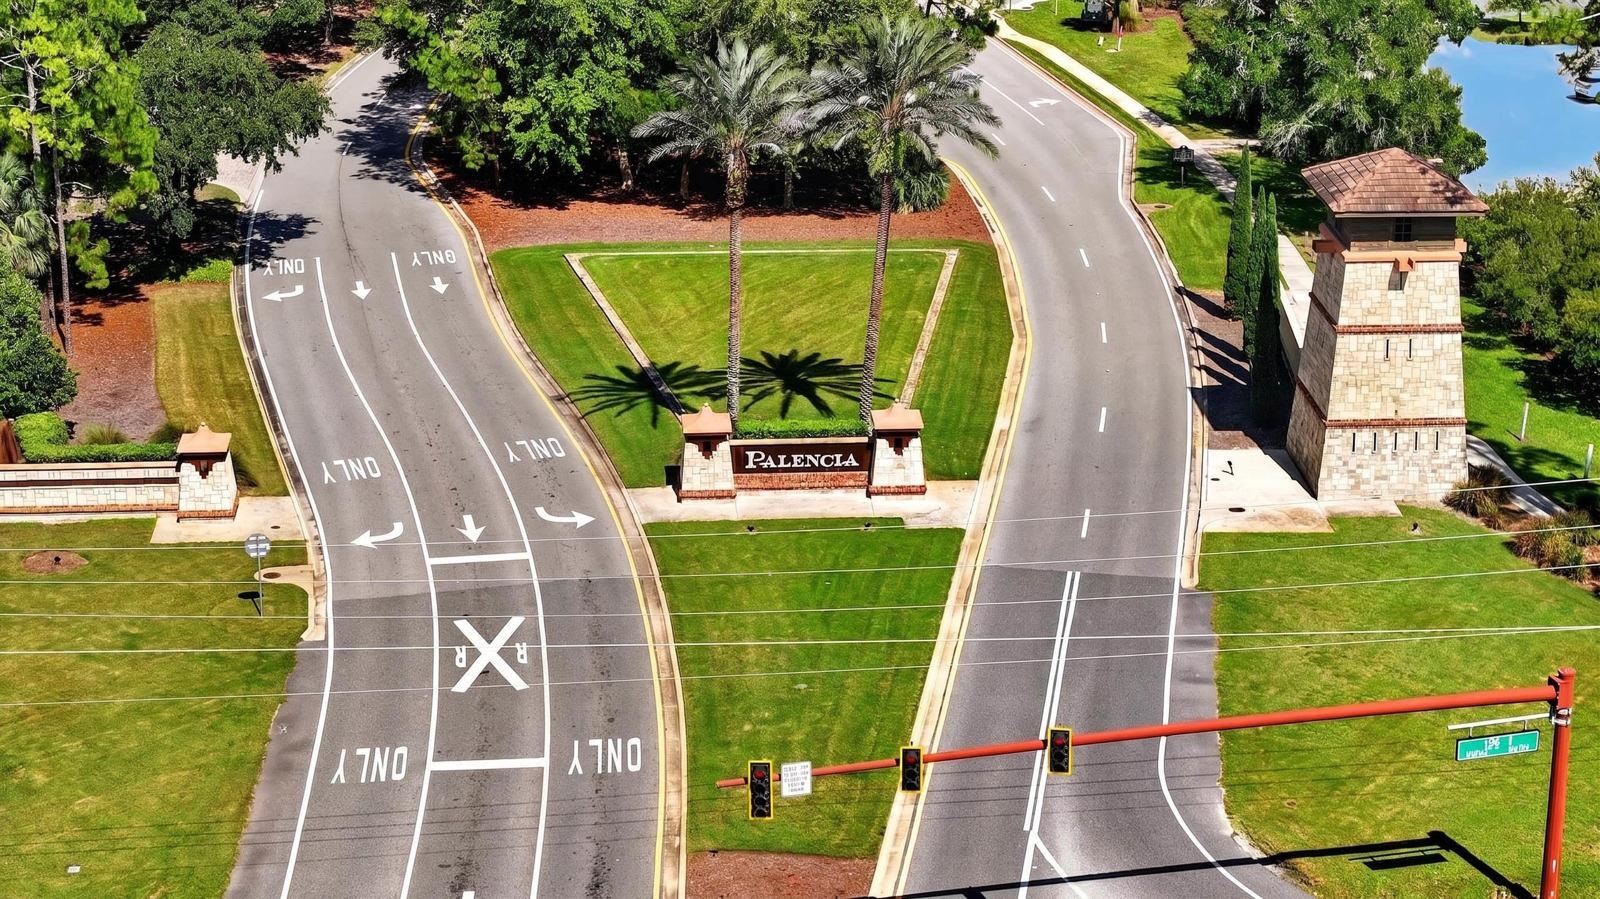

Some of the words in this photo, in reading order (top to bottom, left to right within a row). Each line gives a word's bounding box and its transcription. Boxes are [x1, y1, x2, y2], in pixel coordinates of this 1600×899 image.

[263, 258, 304, 276] ONLY
[412, 249, 456, 267] ONLY
[503, 437, 567, 462] ONLY
[745, 451, 859, 469] PALENCIA
[322, 456, 381, 484] ONLY
[331, 746, 408, 784] ONLY
[568, 737, 642, 776] ONLY
